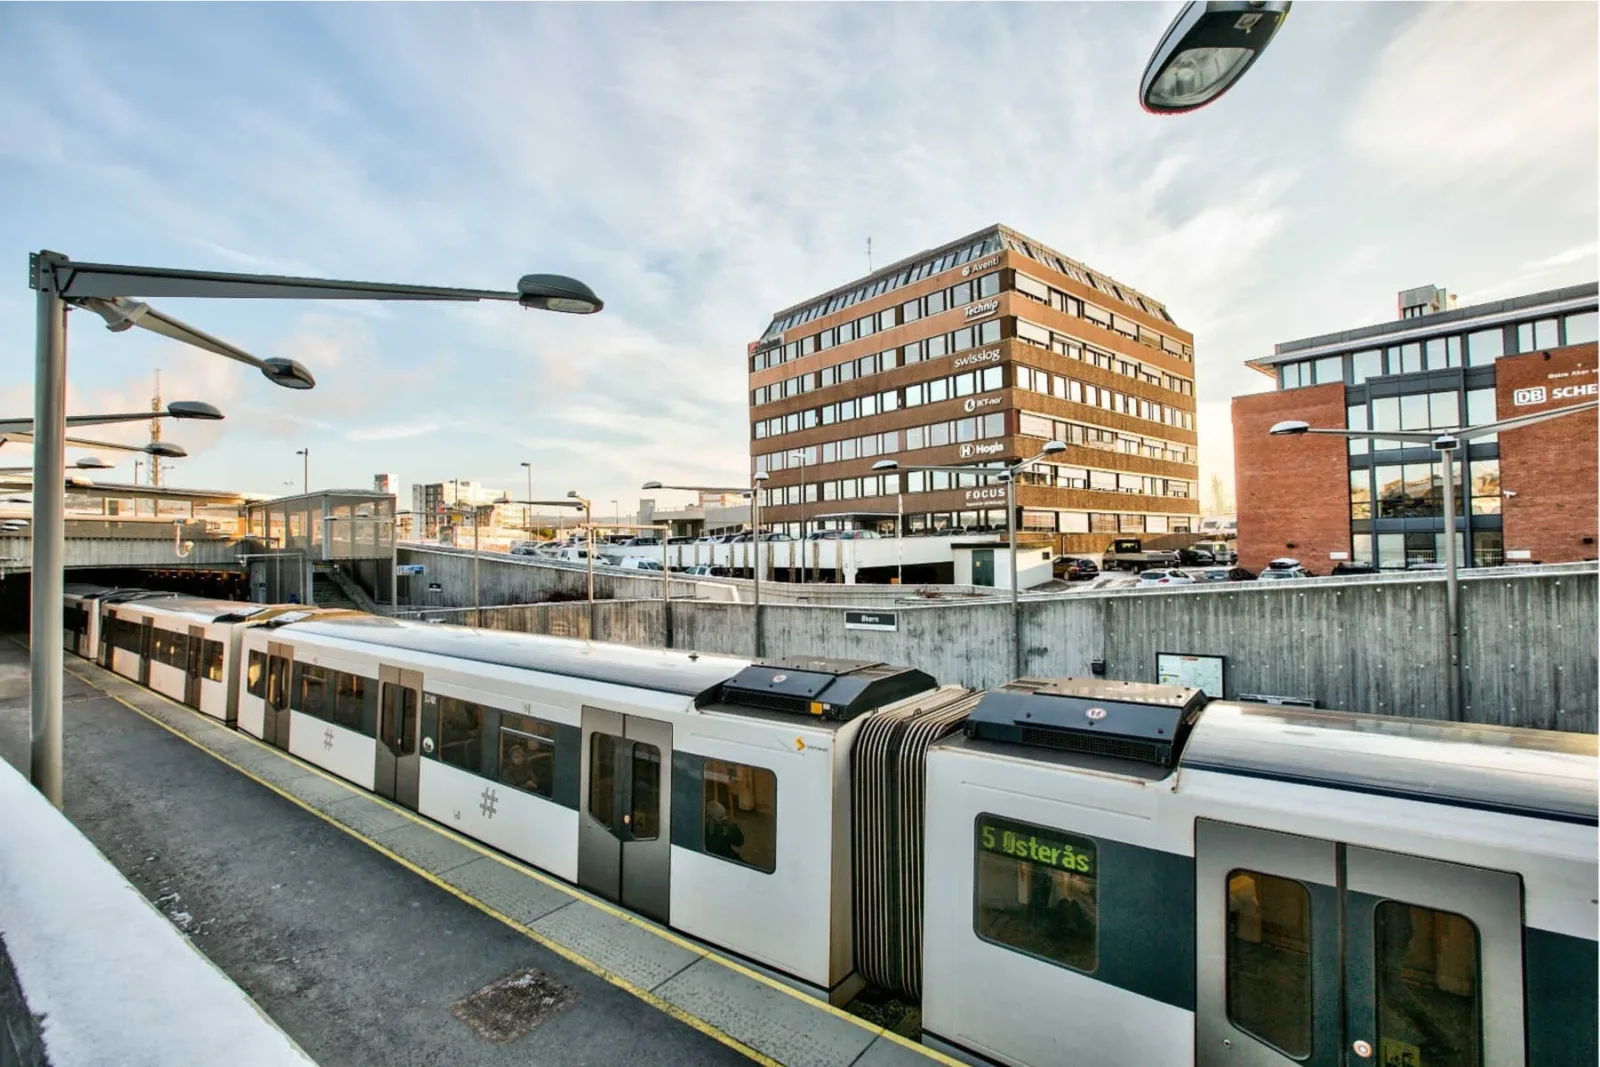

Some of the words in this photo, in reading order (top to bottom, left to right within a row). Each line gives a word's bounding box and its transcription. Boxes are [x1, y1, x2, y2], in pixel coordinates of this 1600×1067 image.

[972, 256, 999, 273] Aventi
[964, 301, 999, 316] Technip
[954, 349, 1001, 368] swisslog
[1518, 390, 1543, 403] DB
[1552, 384, 1599, 399] SCHE
[976, 442, 1004, 454] Hogia
[966, 488, 1006, 500] FOCUS
[982, 824, 996, 849] 5
[1002, 831, 1090, 873] Østerås
